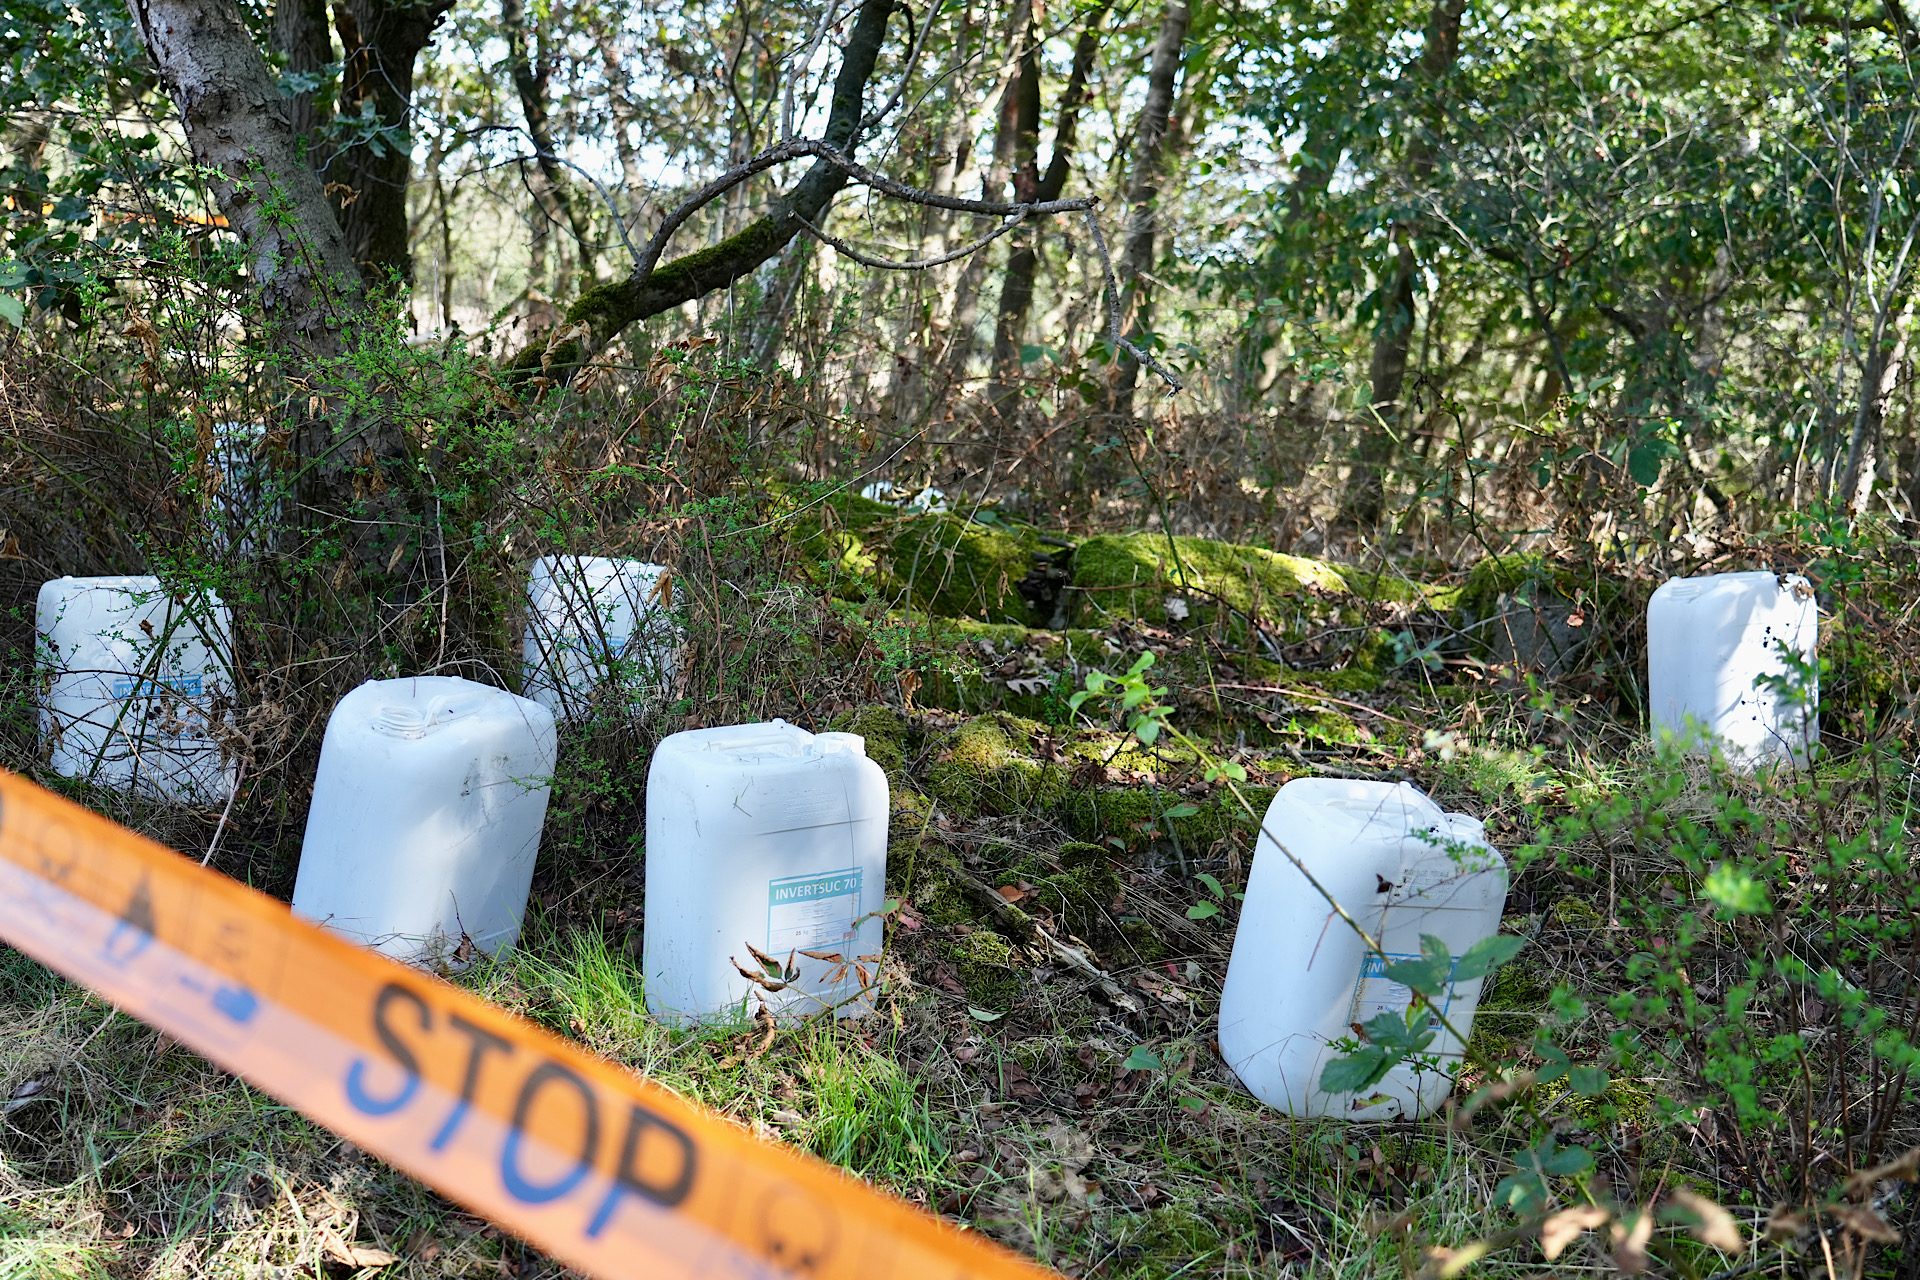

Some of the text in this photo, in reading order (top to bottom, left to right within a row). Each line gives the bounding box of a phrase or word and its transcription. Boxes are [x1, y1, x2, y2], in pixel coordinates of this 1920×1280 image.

[775, 878, 857, 900] INVERTSUC 70
[345, 982, 698, 1239] STOP
